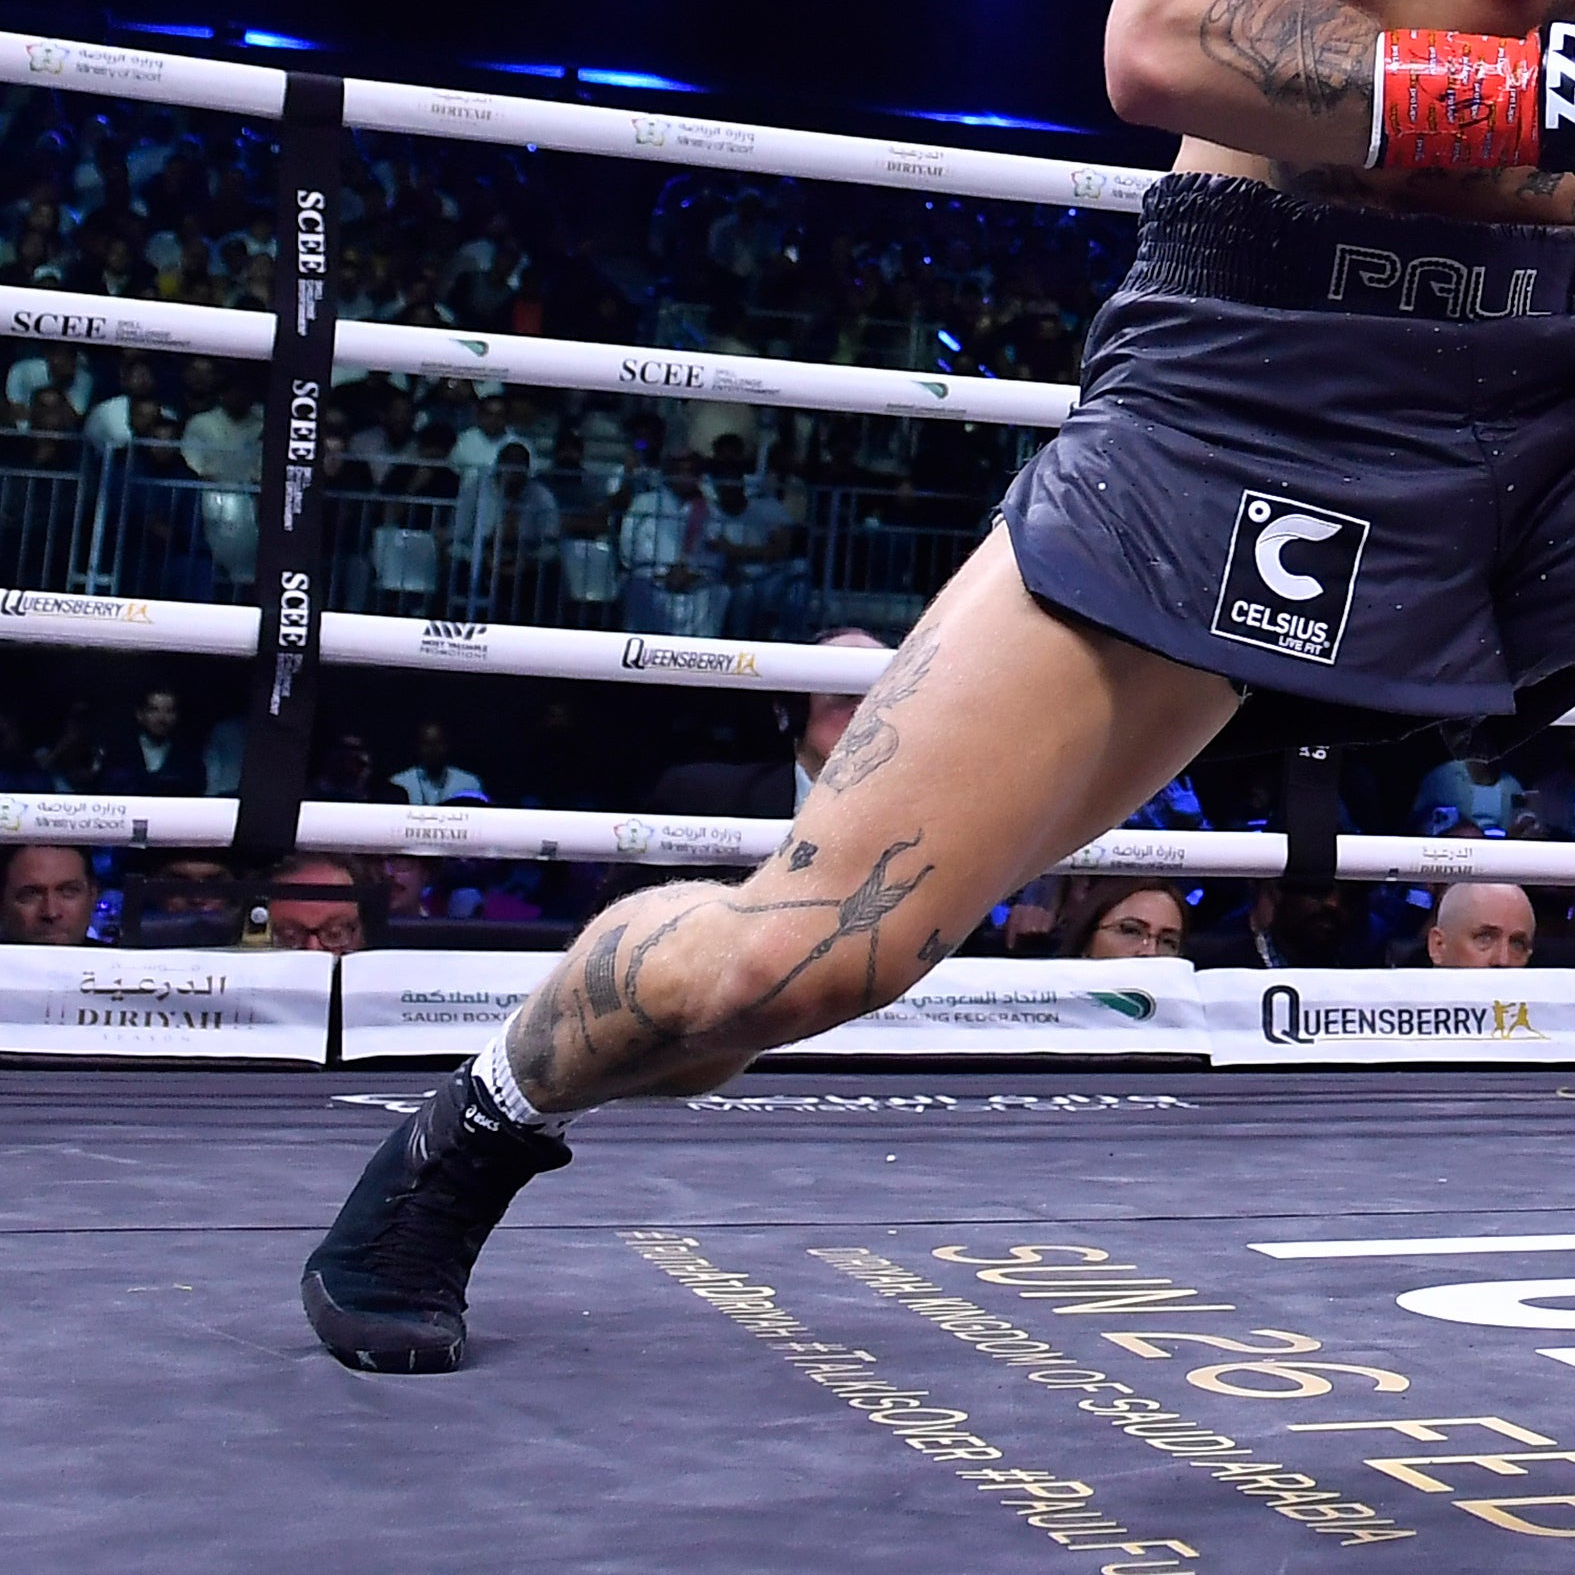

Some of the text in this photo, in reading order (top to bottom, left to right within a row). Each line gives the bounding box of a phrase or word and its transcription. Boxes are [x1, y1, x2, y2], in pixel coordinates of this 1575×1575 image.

[886, 161, 943, 177] DIRIYAH
[297, 190, 326, 275] SCEE
[1327, 242, 1552, 320] PAUL
[10, 311, 107, 340] SCEE
[619, 358, 705, 389] SCEE
[288, 380, 320, 461] SCEE
[1, 591, 125, 618] QUEENSBERRY
[279, 571, 310, 648] SCEE
[1230, 599, 1328, 644] CELSIUS
[622, 637, 736, 673] QUEENSBERRY
[1278, 635, 1323, 657] LIVE FIT
[404, 825, 468, 841] DIRIYAH
[77, 1007, 223, 1031] DIRIYAH
[401, 1012, 509, 1024] SAUDI BOXI
[954, 1011, 1059, 1024] FEDERATION
[1262, 984, 1487, 1044] QUEENSBERRY
[898, 1297, 1078, 1365] KINGDOM
[931, 1244, 1237, 1315] SUN
[1100, 1328, 1412, 1399] 26
[1027, 1368, 1134, 1396] OF
[1078, 1398, 1253, 1457] SAUDI
[1189, 1461, 1417, 1547] ARABIA
